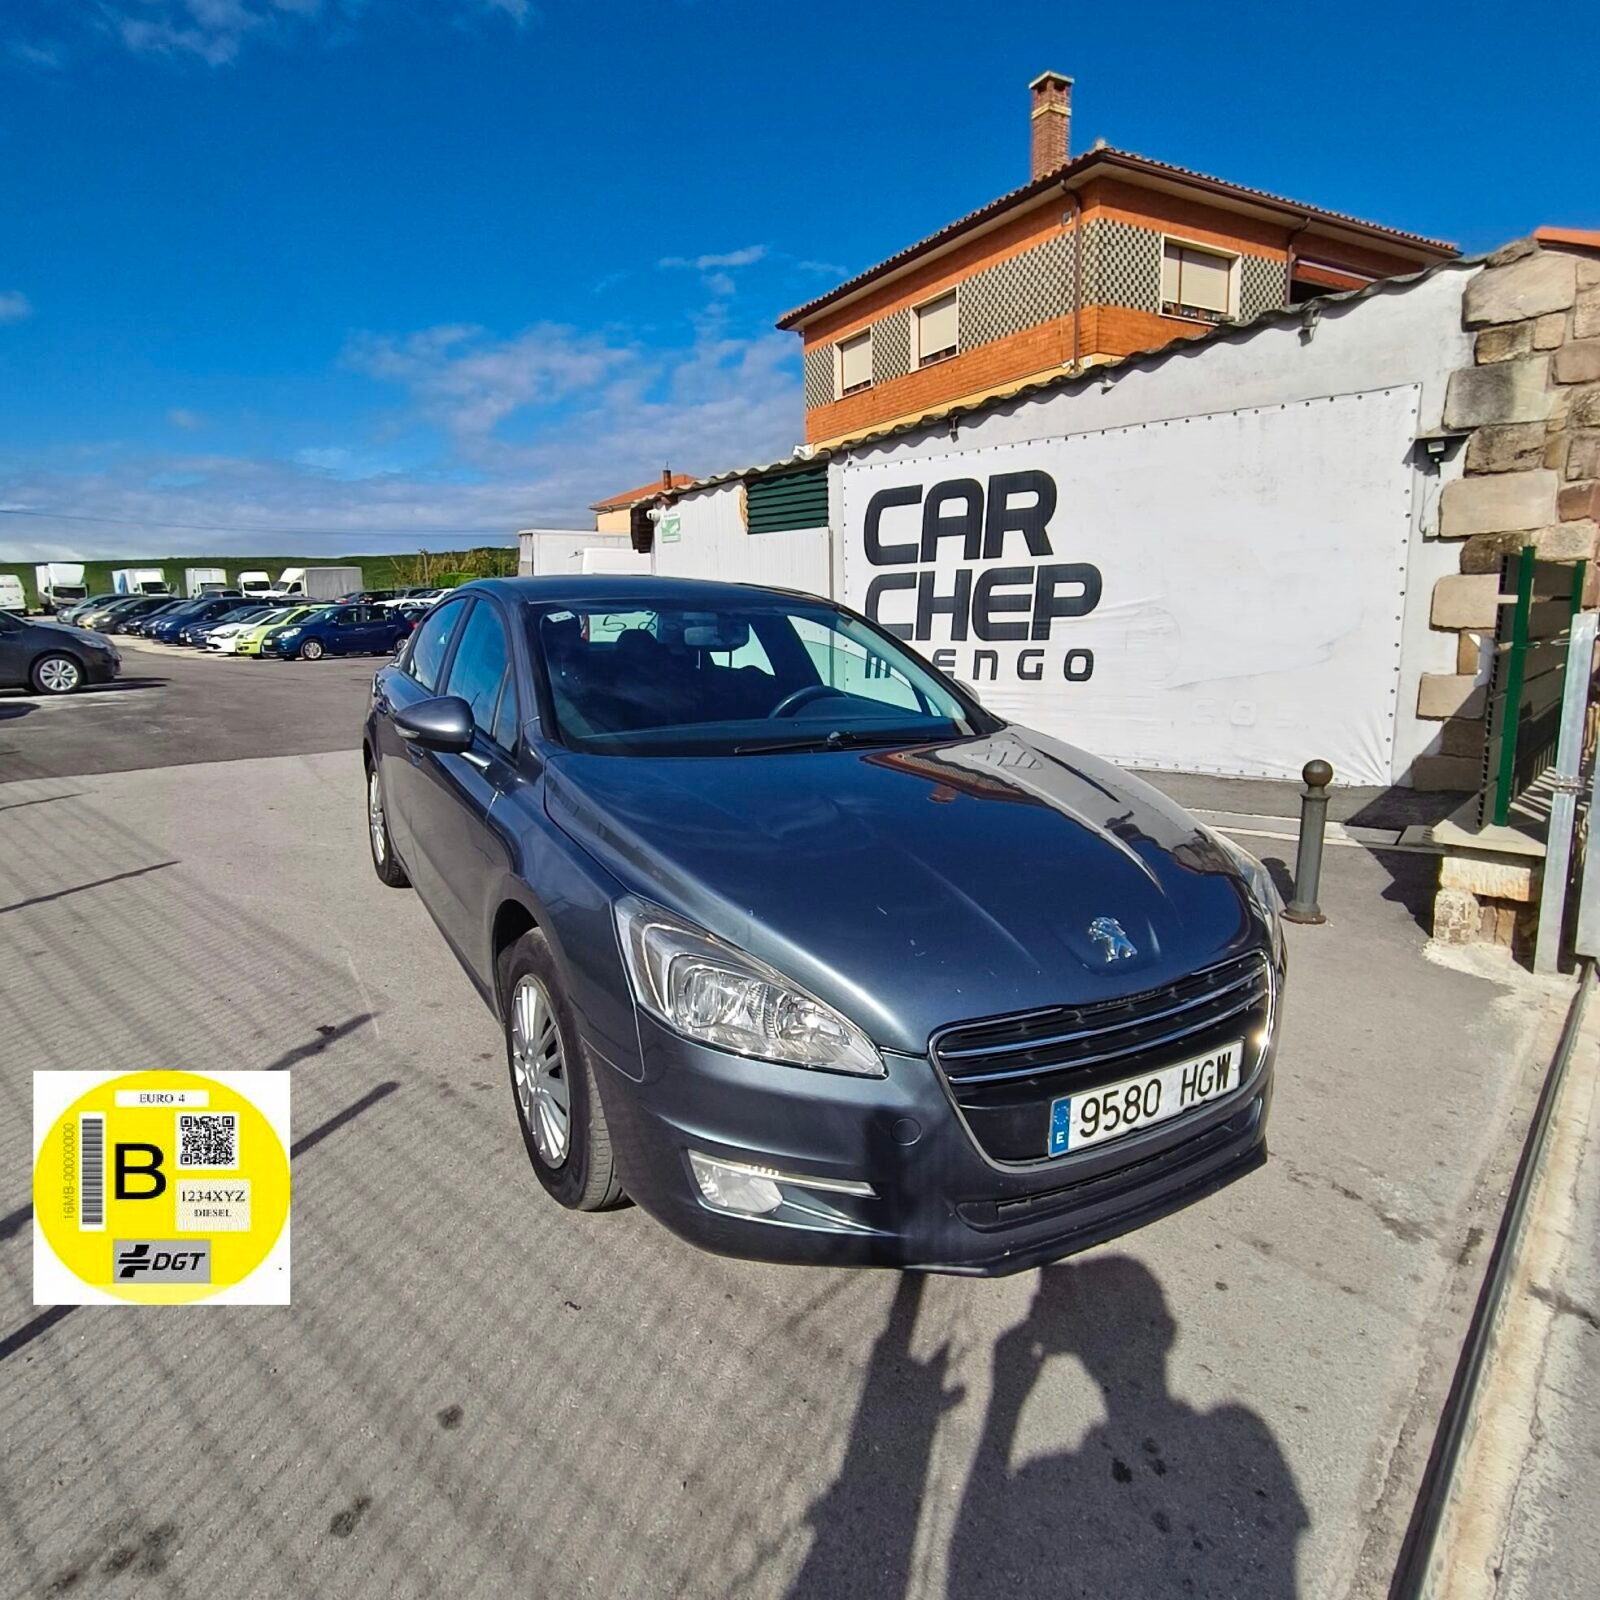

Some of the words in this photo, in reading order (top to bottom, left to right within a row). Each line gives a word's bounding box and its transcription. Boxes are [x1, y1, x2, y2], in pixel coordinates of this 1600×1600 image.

[864, 469, 1057, 566] CAR
[865, 562, 1103, 641] CHEP
[1079, 1078, 1162, 1138] 9580
[1179, 1051, 1232, 1107] HGW
[1055, 1131, 1065, 1144] E
